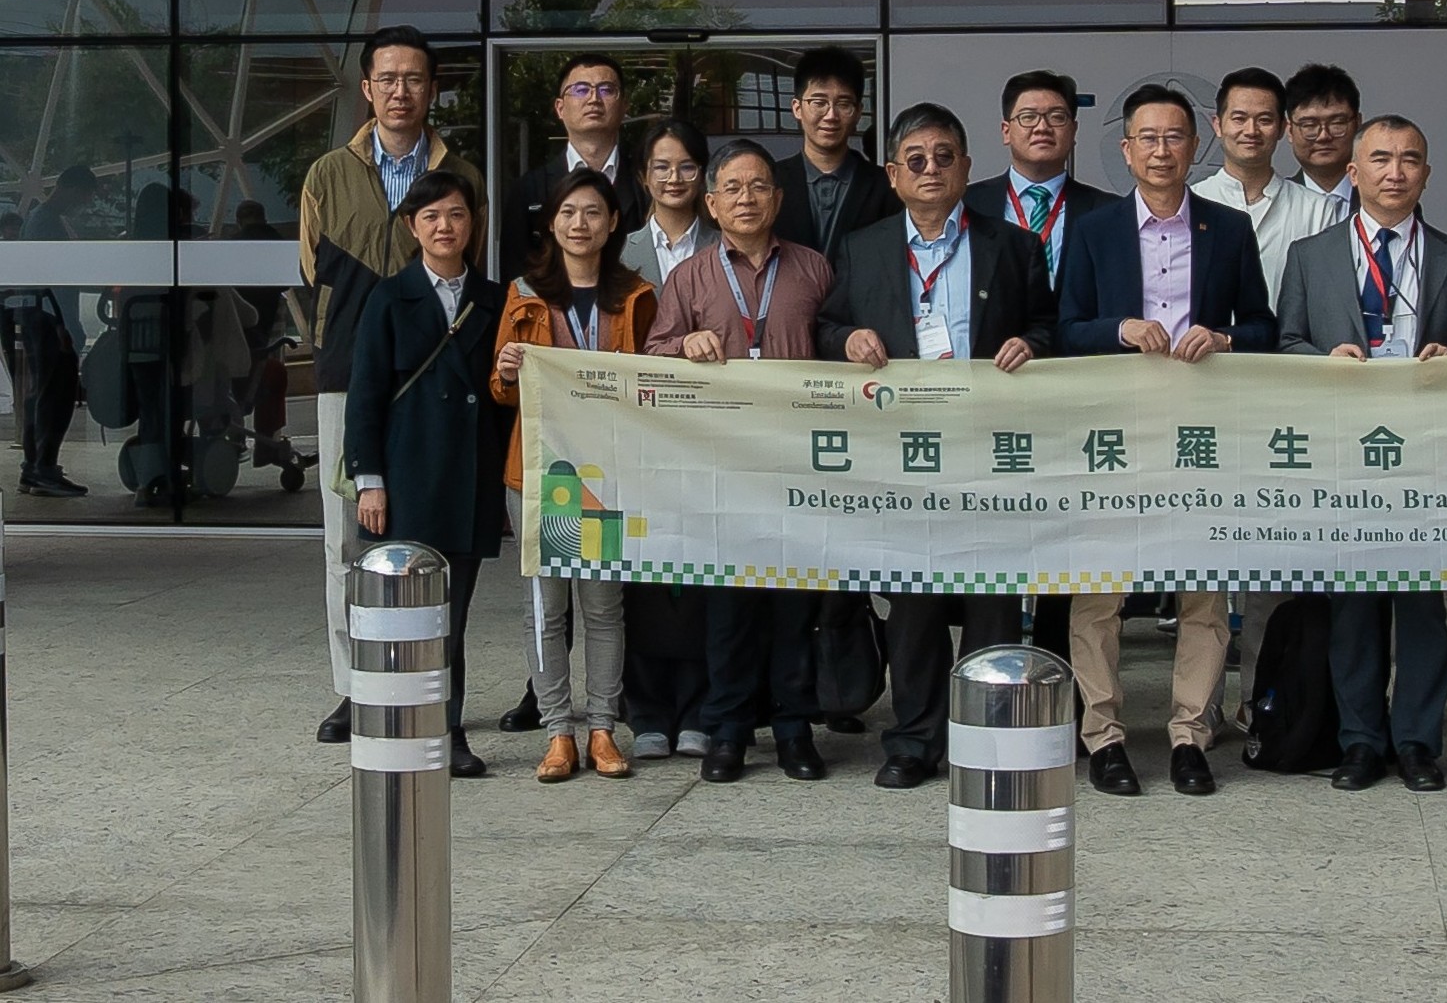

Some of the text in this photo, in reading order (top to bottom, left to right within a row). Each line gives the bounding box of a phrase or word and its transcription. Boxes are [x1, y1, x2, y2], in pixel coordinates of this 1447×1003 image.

[786, 486, 914, 513] Delegação
[922, 491, 951, 510] de
[960, 492, 1048, 512] Estudo
[1058, 498, 1070, 510] e
[1080, 488, 1223, 514] Prospecção
[1234, 496, 1247, 509] a
[1256, 488, 1302, 509] São
[1311, 488, 1394, 512] Paulo,
[1209, 527, 1228, 541] 25
[1233, 527, 1251, 541] de
[1256, 527, 1298, 541] Maio
[1303, 531, 1312, 541] a
[1317, 527, 1325, 541] 1
[1331, 527, 1350, 542] de
[1354, 527, 1404, 542] Junho
[1409, 527, 1427, 542] de
